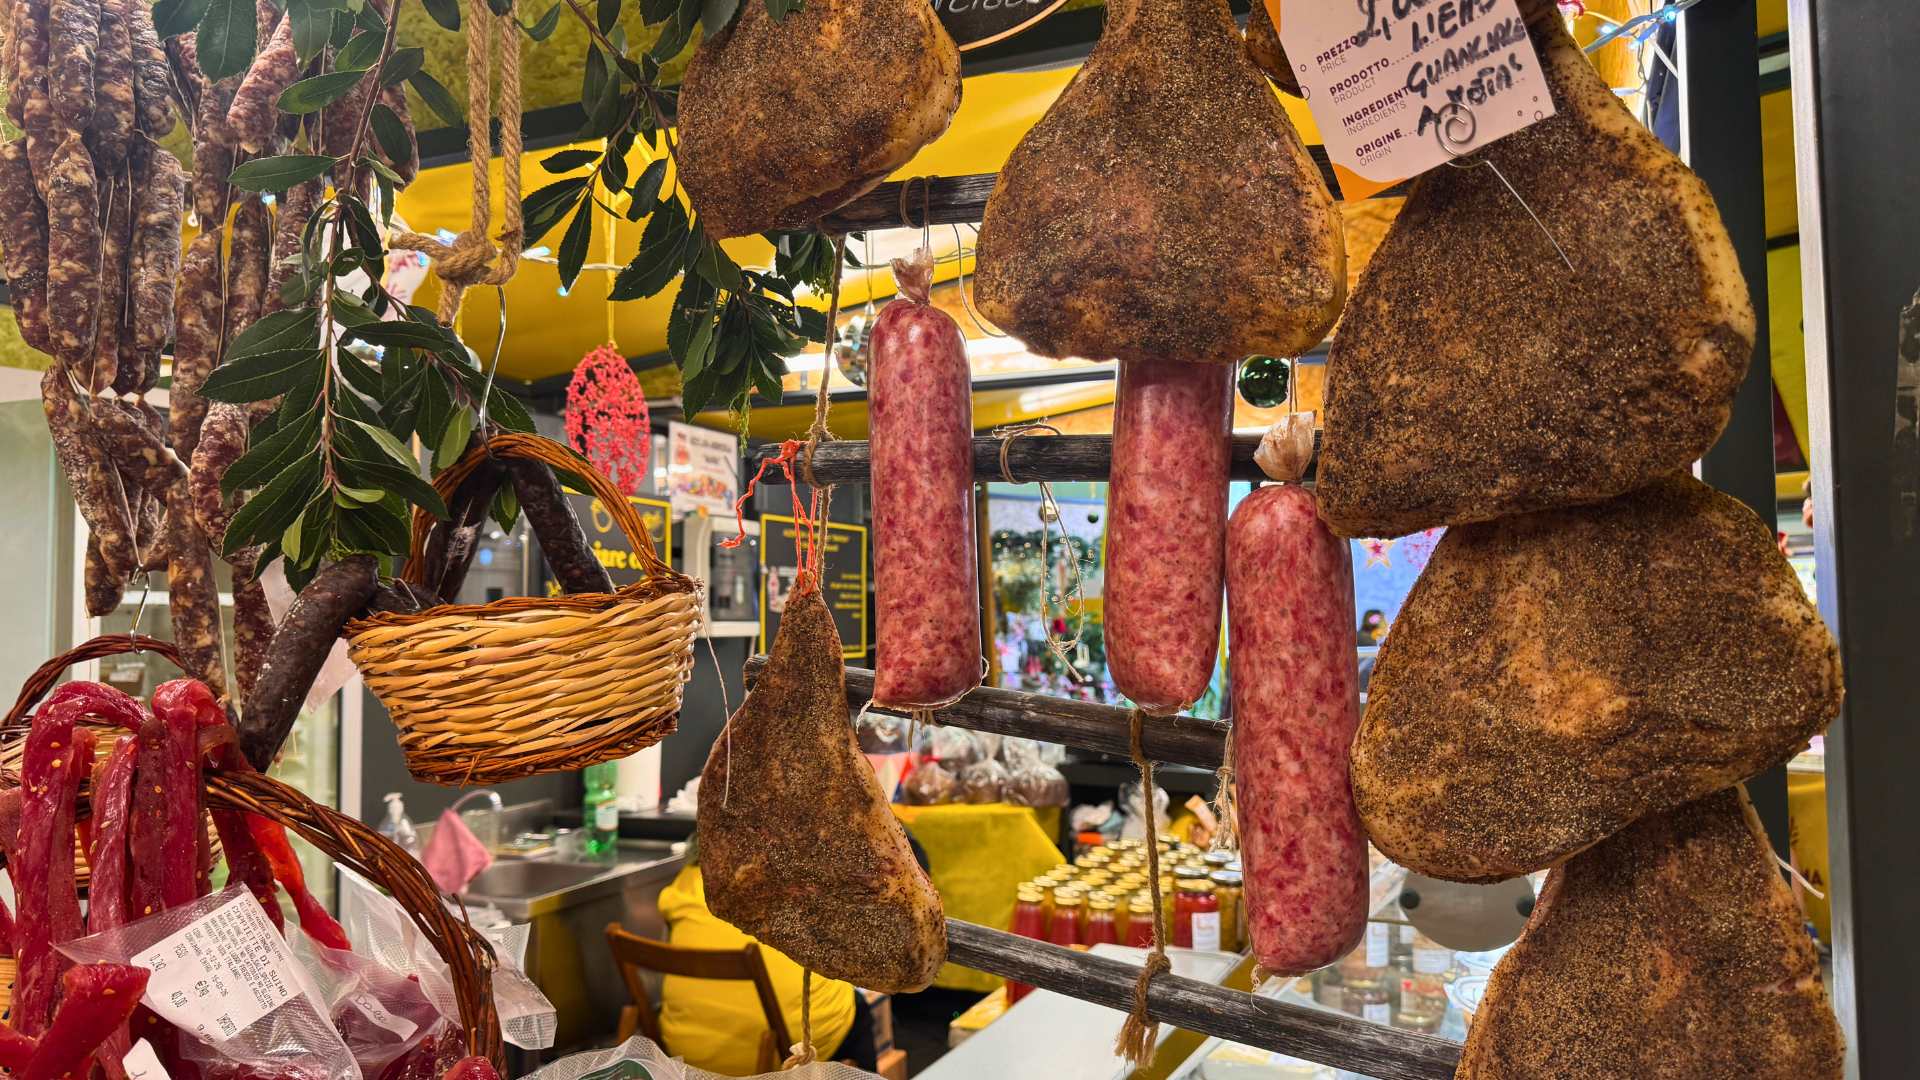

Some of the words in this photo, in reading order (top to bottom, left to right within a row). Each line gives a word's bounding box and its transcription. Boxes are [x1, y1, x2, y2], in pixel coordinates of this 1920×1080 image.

[1316, 35, 1359, 65] PREZZO
[1320, 54, 1348, 75] PRICE
[1328, 57, 1391, 97] PRODOTTO
[1333, 77, 1377, 106] PRODUCT
[1341, 86, 1410, 127] INGREDIENT
[1346, 100, 1408, 137] INGREDIENTS
[1355, 127, 1403, 158] ORIGINE
[1359, 145, 1393, 169] ORIGIN
[230, 905, 261, 951] COPPIETTE
[259, 955, 269, 966] DI
[268, 970, 287, 997] SUINO
